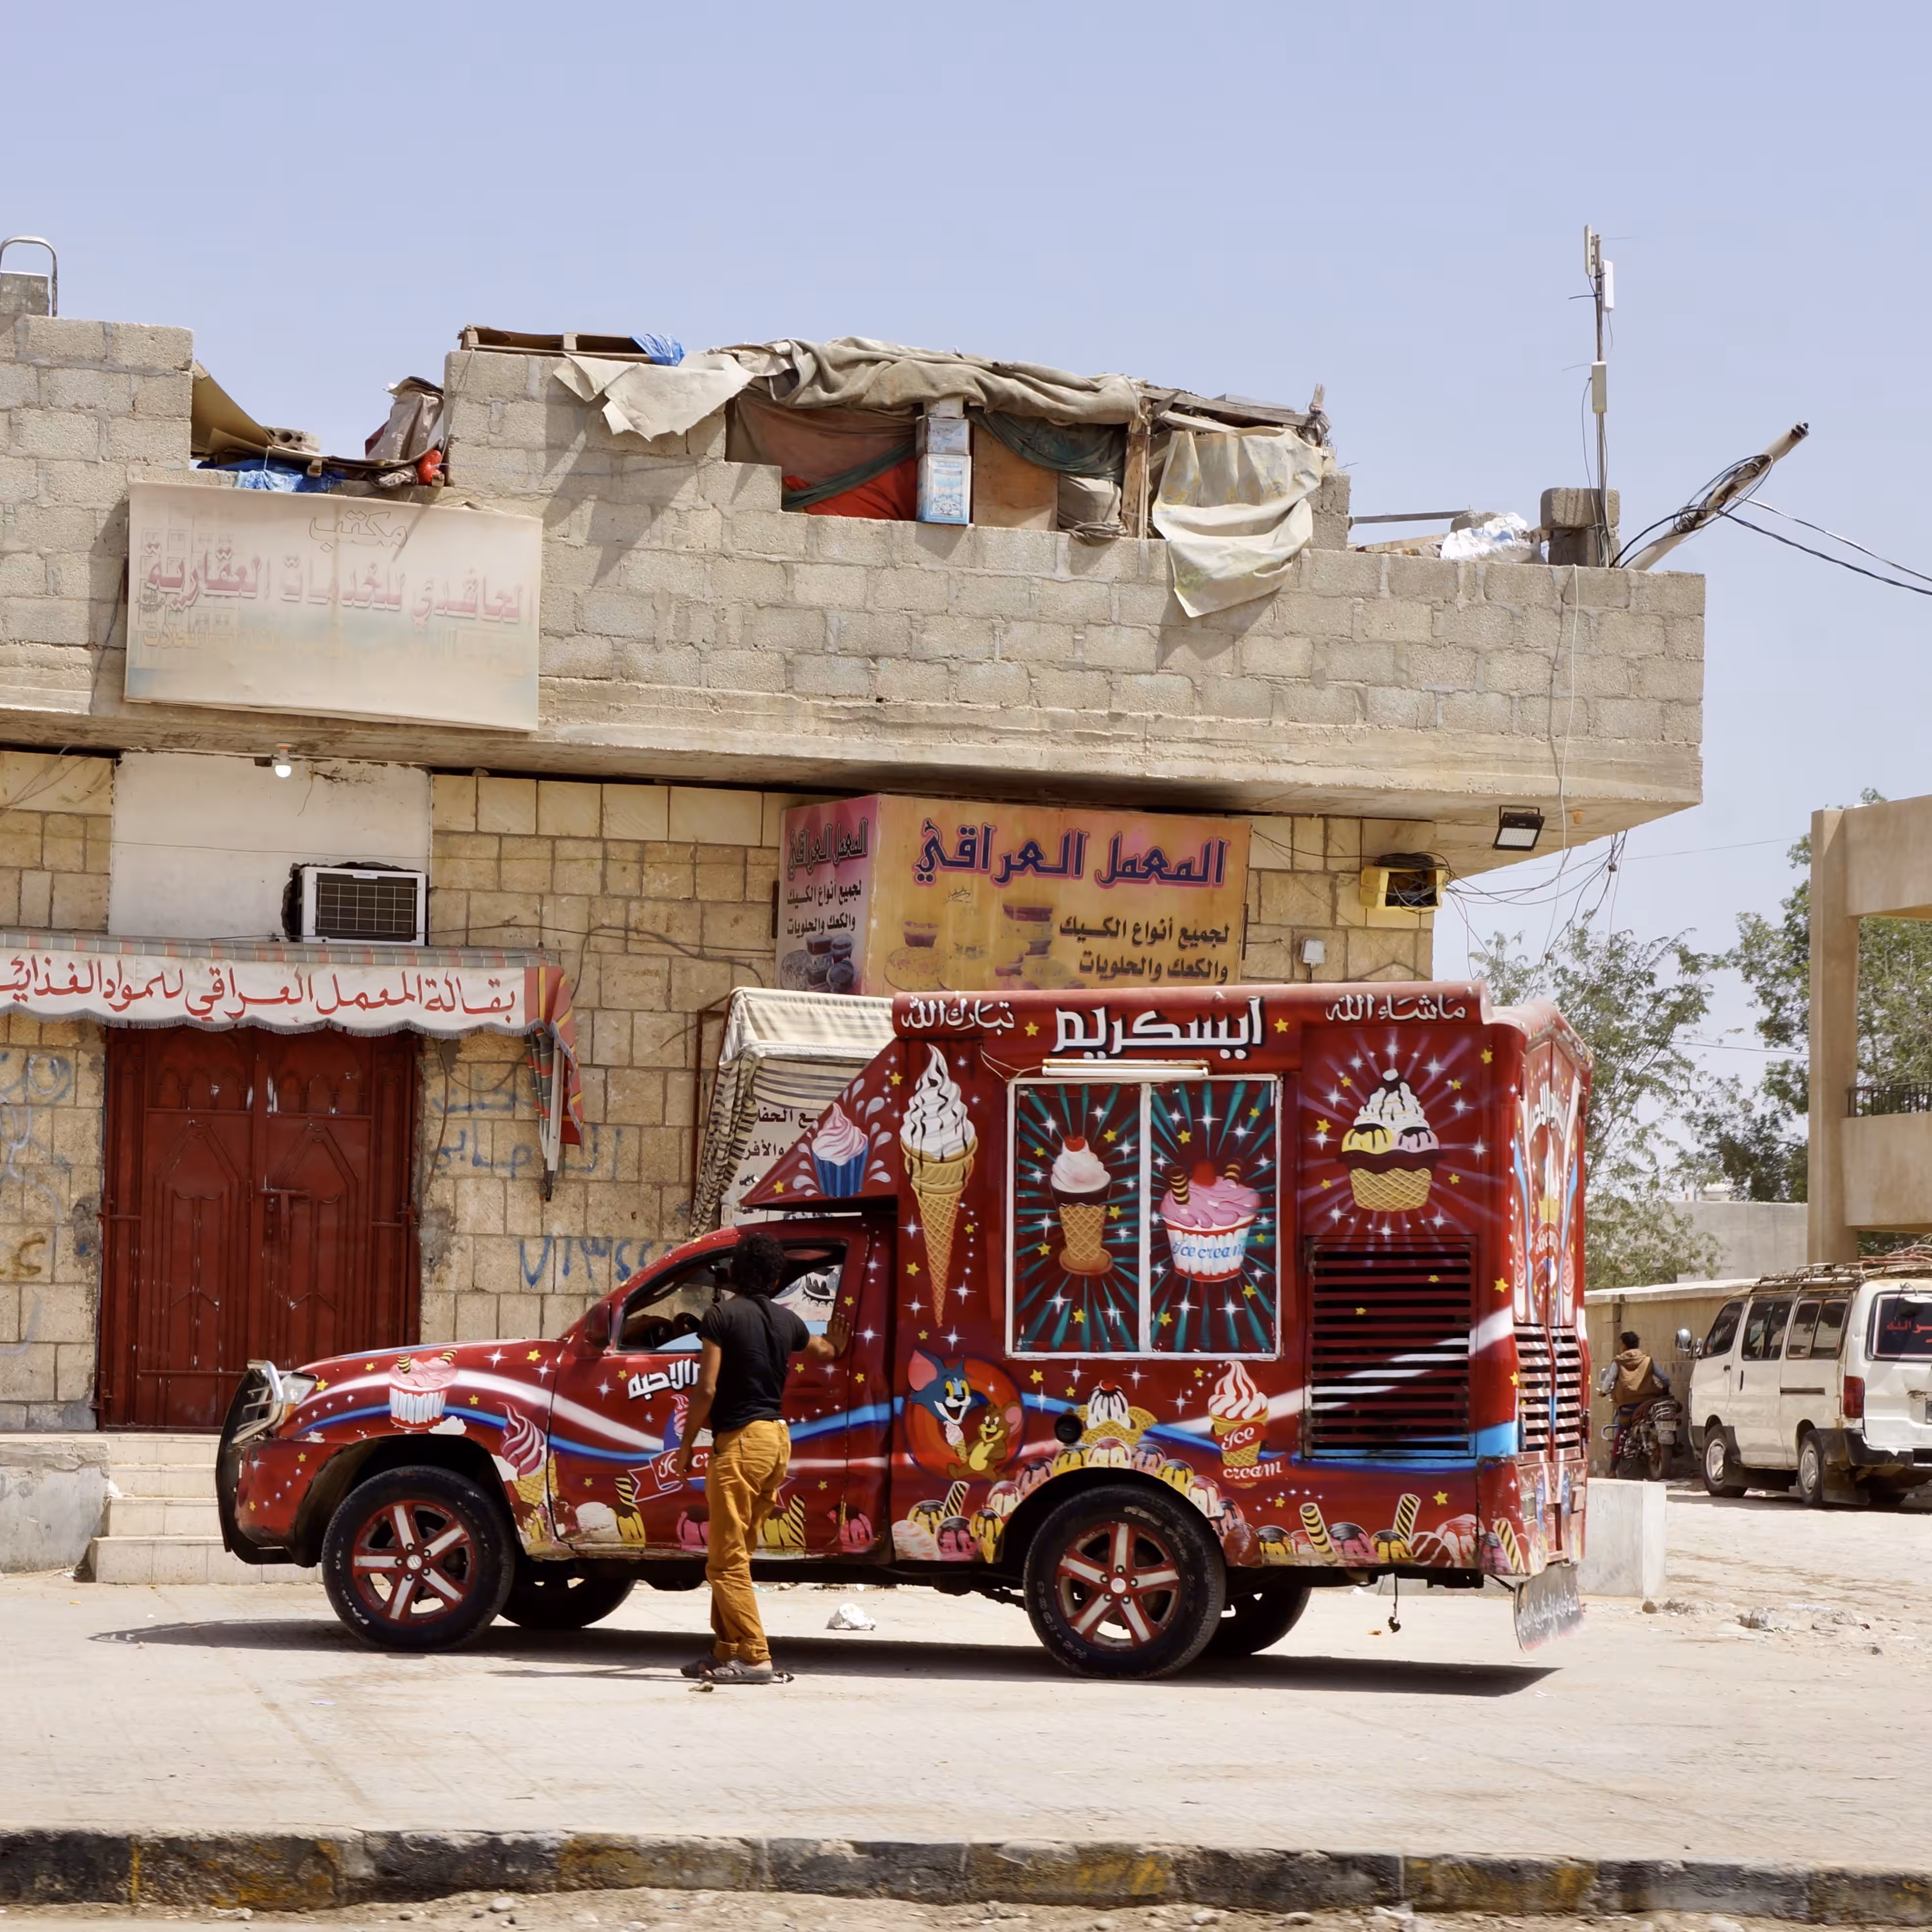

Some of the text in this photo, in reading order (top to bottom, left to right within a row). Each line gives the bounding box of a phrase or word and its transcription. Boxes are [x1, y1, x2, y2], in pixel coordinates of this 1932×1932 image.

[308, 509, 407, 553] مكتب
[146, 541, 271, 611] العقارية
[788, 818, 868, 880] المعمل العراقي
[914, 818, 1232, 888] المعمل العراقي
[787, 884, 816, 909] الكيك
[839, 879, 862, 905] لجميع
[787, 912, 856, 939] والكعك والحلويات
[1060, 915, 1229, 950] لجميع أنواع الكيك
[1079, 950, 1228, 985] والكعك والحلويات
[0, 955, 515, 1024] بقالة المعمل العراقي للمواد الغذائي
[1325, 994, 1375, 1022] الله
[1050, 996, 1263, 1060] ايسكريم
[1223, 1461, 1283, 1479] cream
